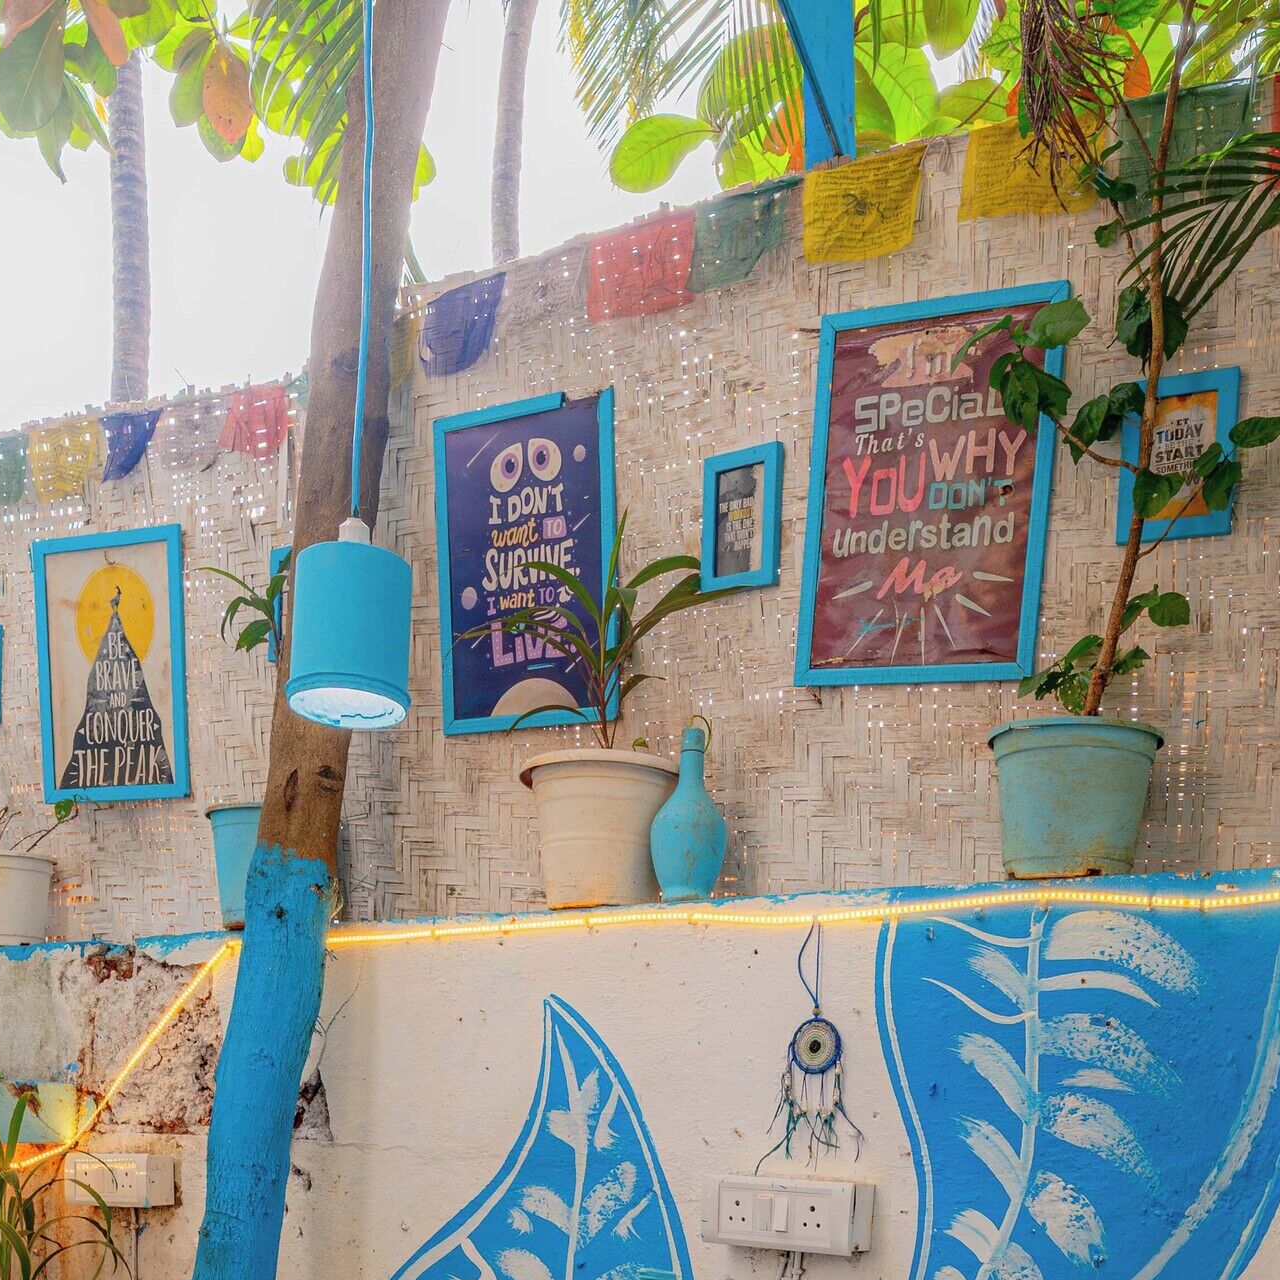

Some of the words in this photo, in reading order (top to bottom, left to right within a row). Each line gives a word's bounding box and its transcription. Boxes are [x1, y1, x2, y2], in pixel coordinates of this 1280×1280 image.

[855, 428, 925, 456] That's
[929, 428, 1027, 482] WHY
[1155, 444, 1204, 464] START
[488, 495, 502, 525] I
[508, 482, 564, 523] DON'T
[928, 477, 1014, 511] DON'T
[491, 517, 539, 547] want
[544, 519, 562, 537] TO
[876, 557, 963, 601] Me
[487, 597, 497, 616] I
[500, 588, 535, 610] want
[539, 586, 555, 604] TO
[108, 631, 125, 660] BE
[95, 658, 140, 691] BRAVE
[109, 691, 127, 708] AND
[85, 708, 155, 747] CONQUER
[74, 748, 109, 787] THE
[113, 744, 163, 787] PEAK
